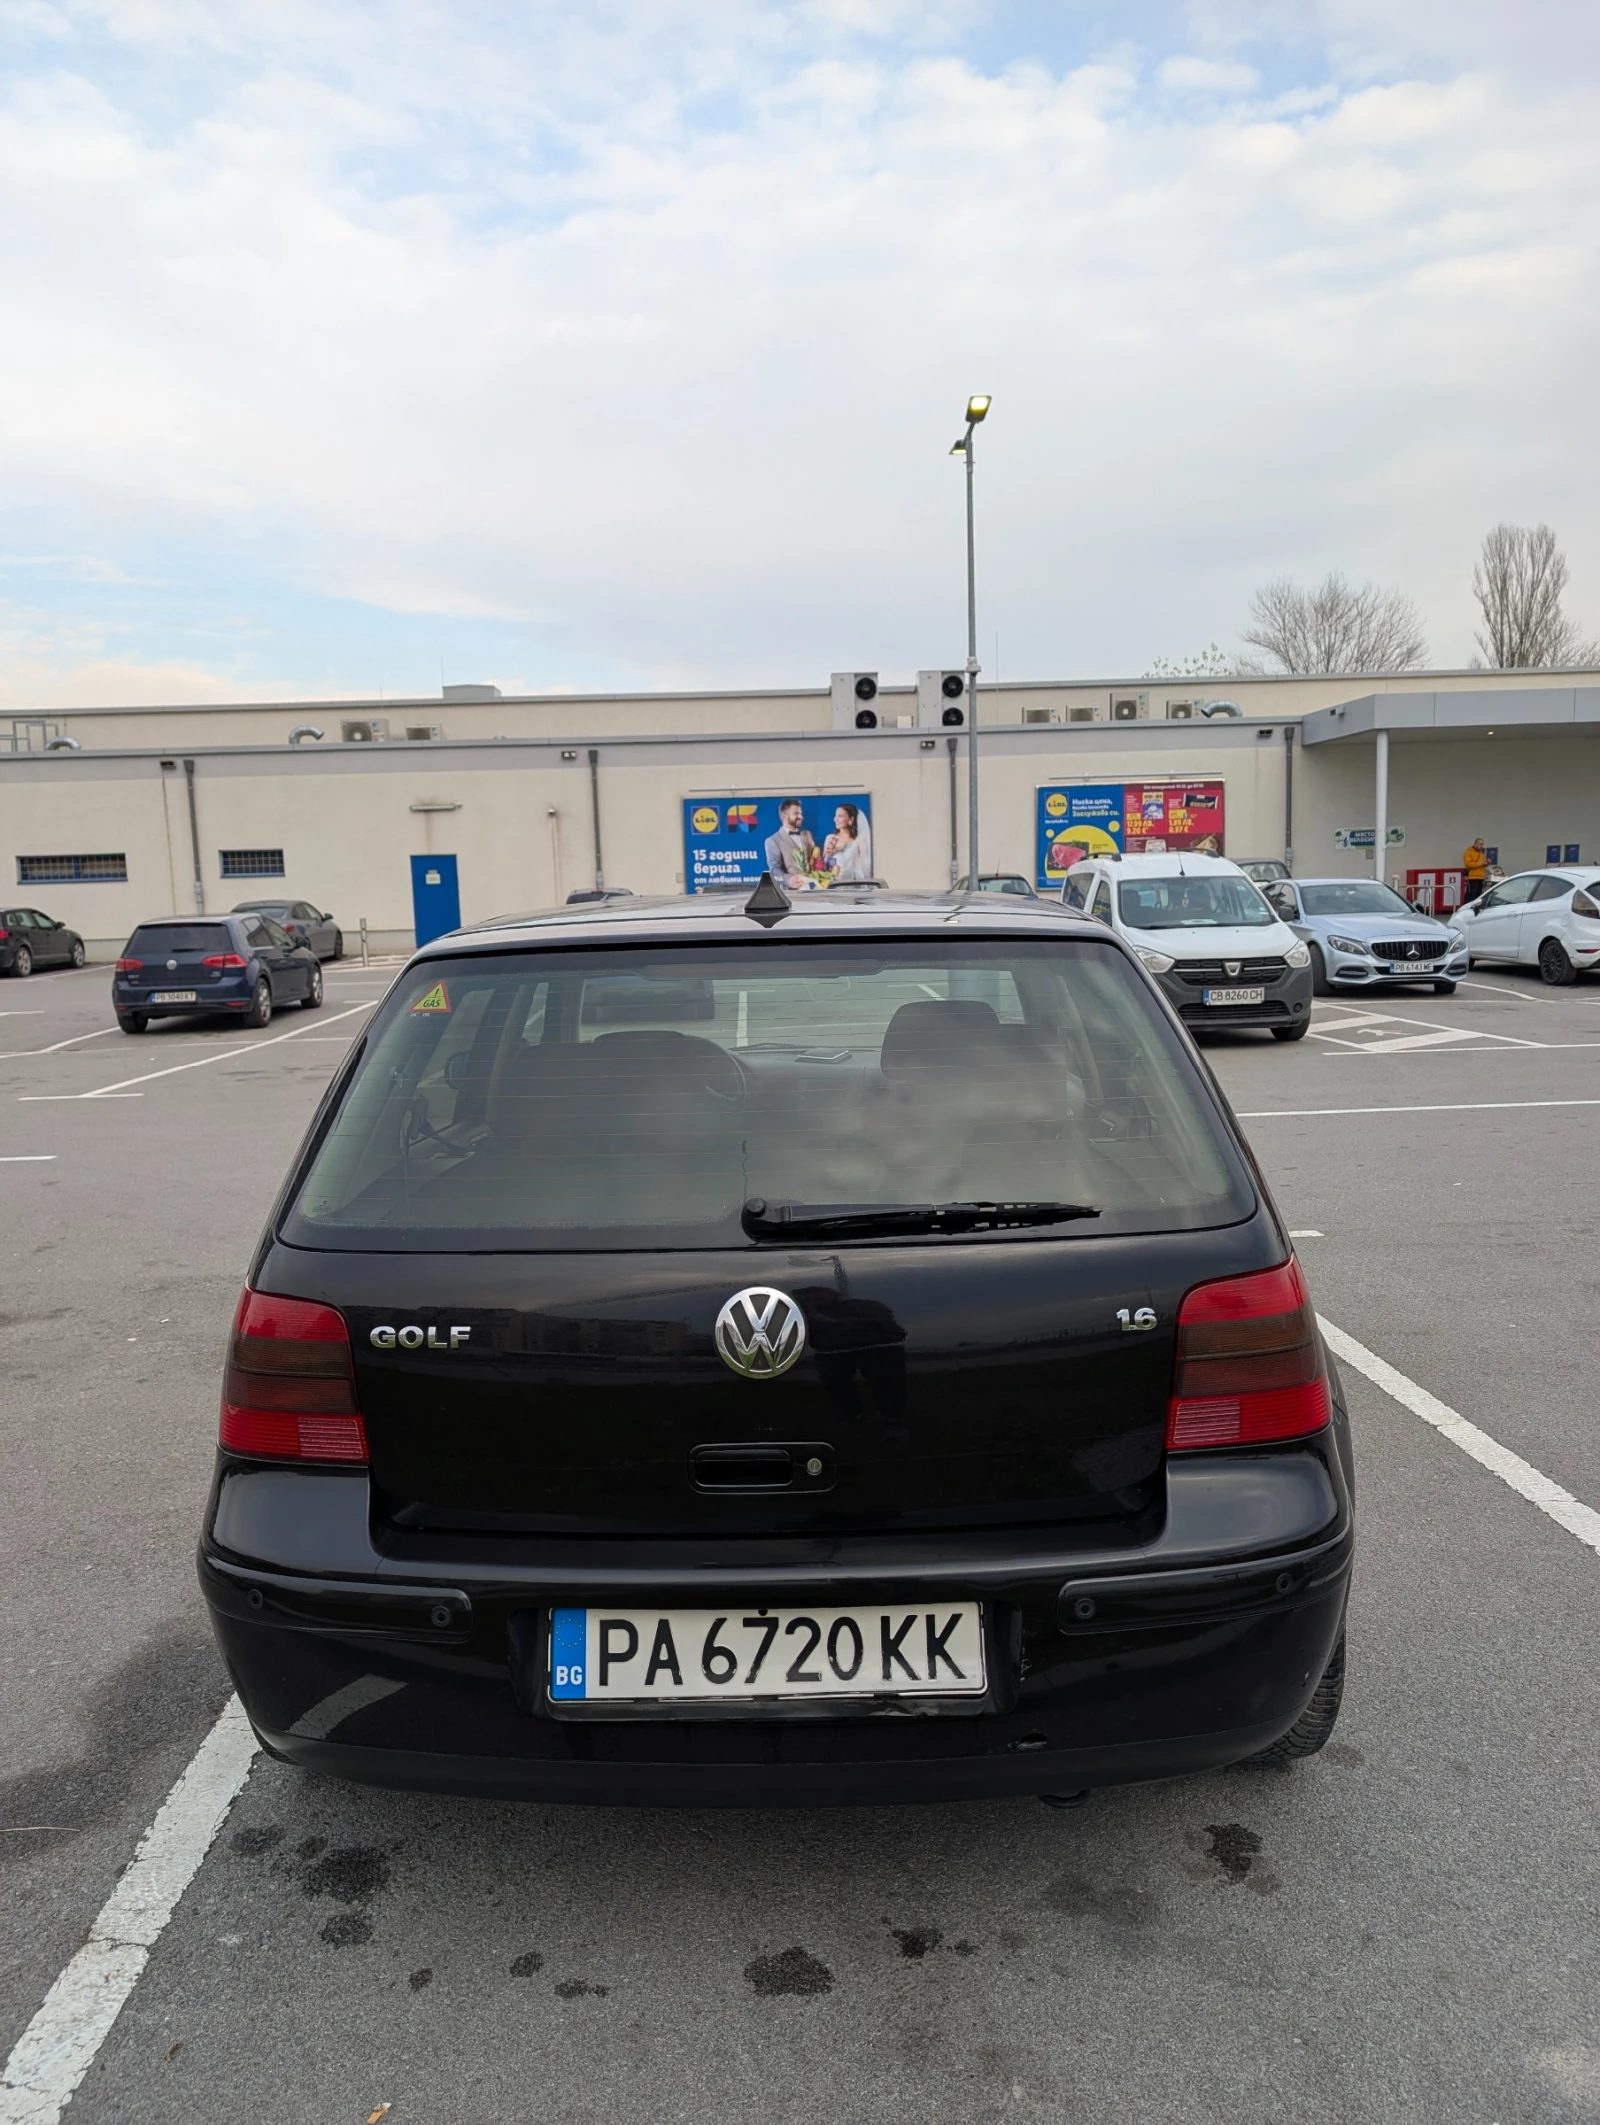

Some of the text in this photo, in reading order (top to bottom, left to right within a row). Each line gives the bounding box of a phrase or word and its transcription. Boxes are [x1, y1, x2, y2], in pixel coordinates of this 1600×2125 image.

[692, 849, 758, 863] 15 години
[693, 862, 741, 876] верига
[708, 876, 742, 884] любими
[1406, 963, 1422, 971] 6143
[185, 992, 194, 1000] KT
[1210, 990, 1262, 1000] CB 8260 CH
[423, 999, 441, 1007] GAS
[1116, 1307, 1158, 1331] 1.6
[369, 1325, 471, 1349] GOLF
[599, 1613, 968, 1686] PA 6720 KK
[556, 1666, 583, 1685] BG
